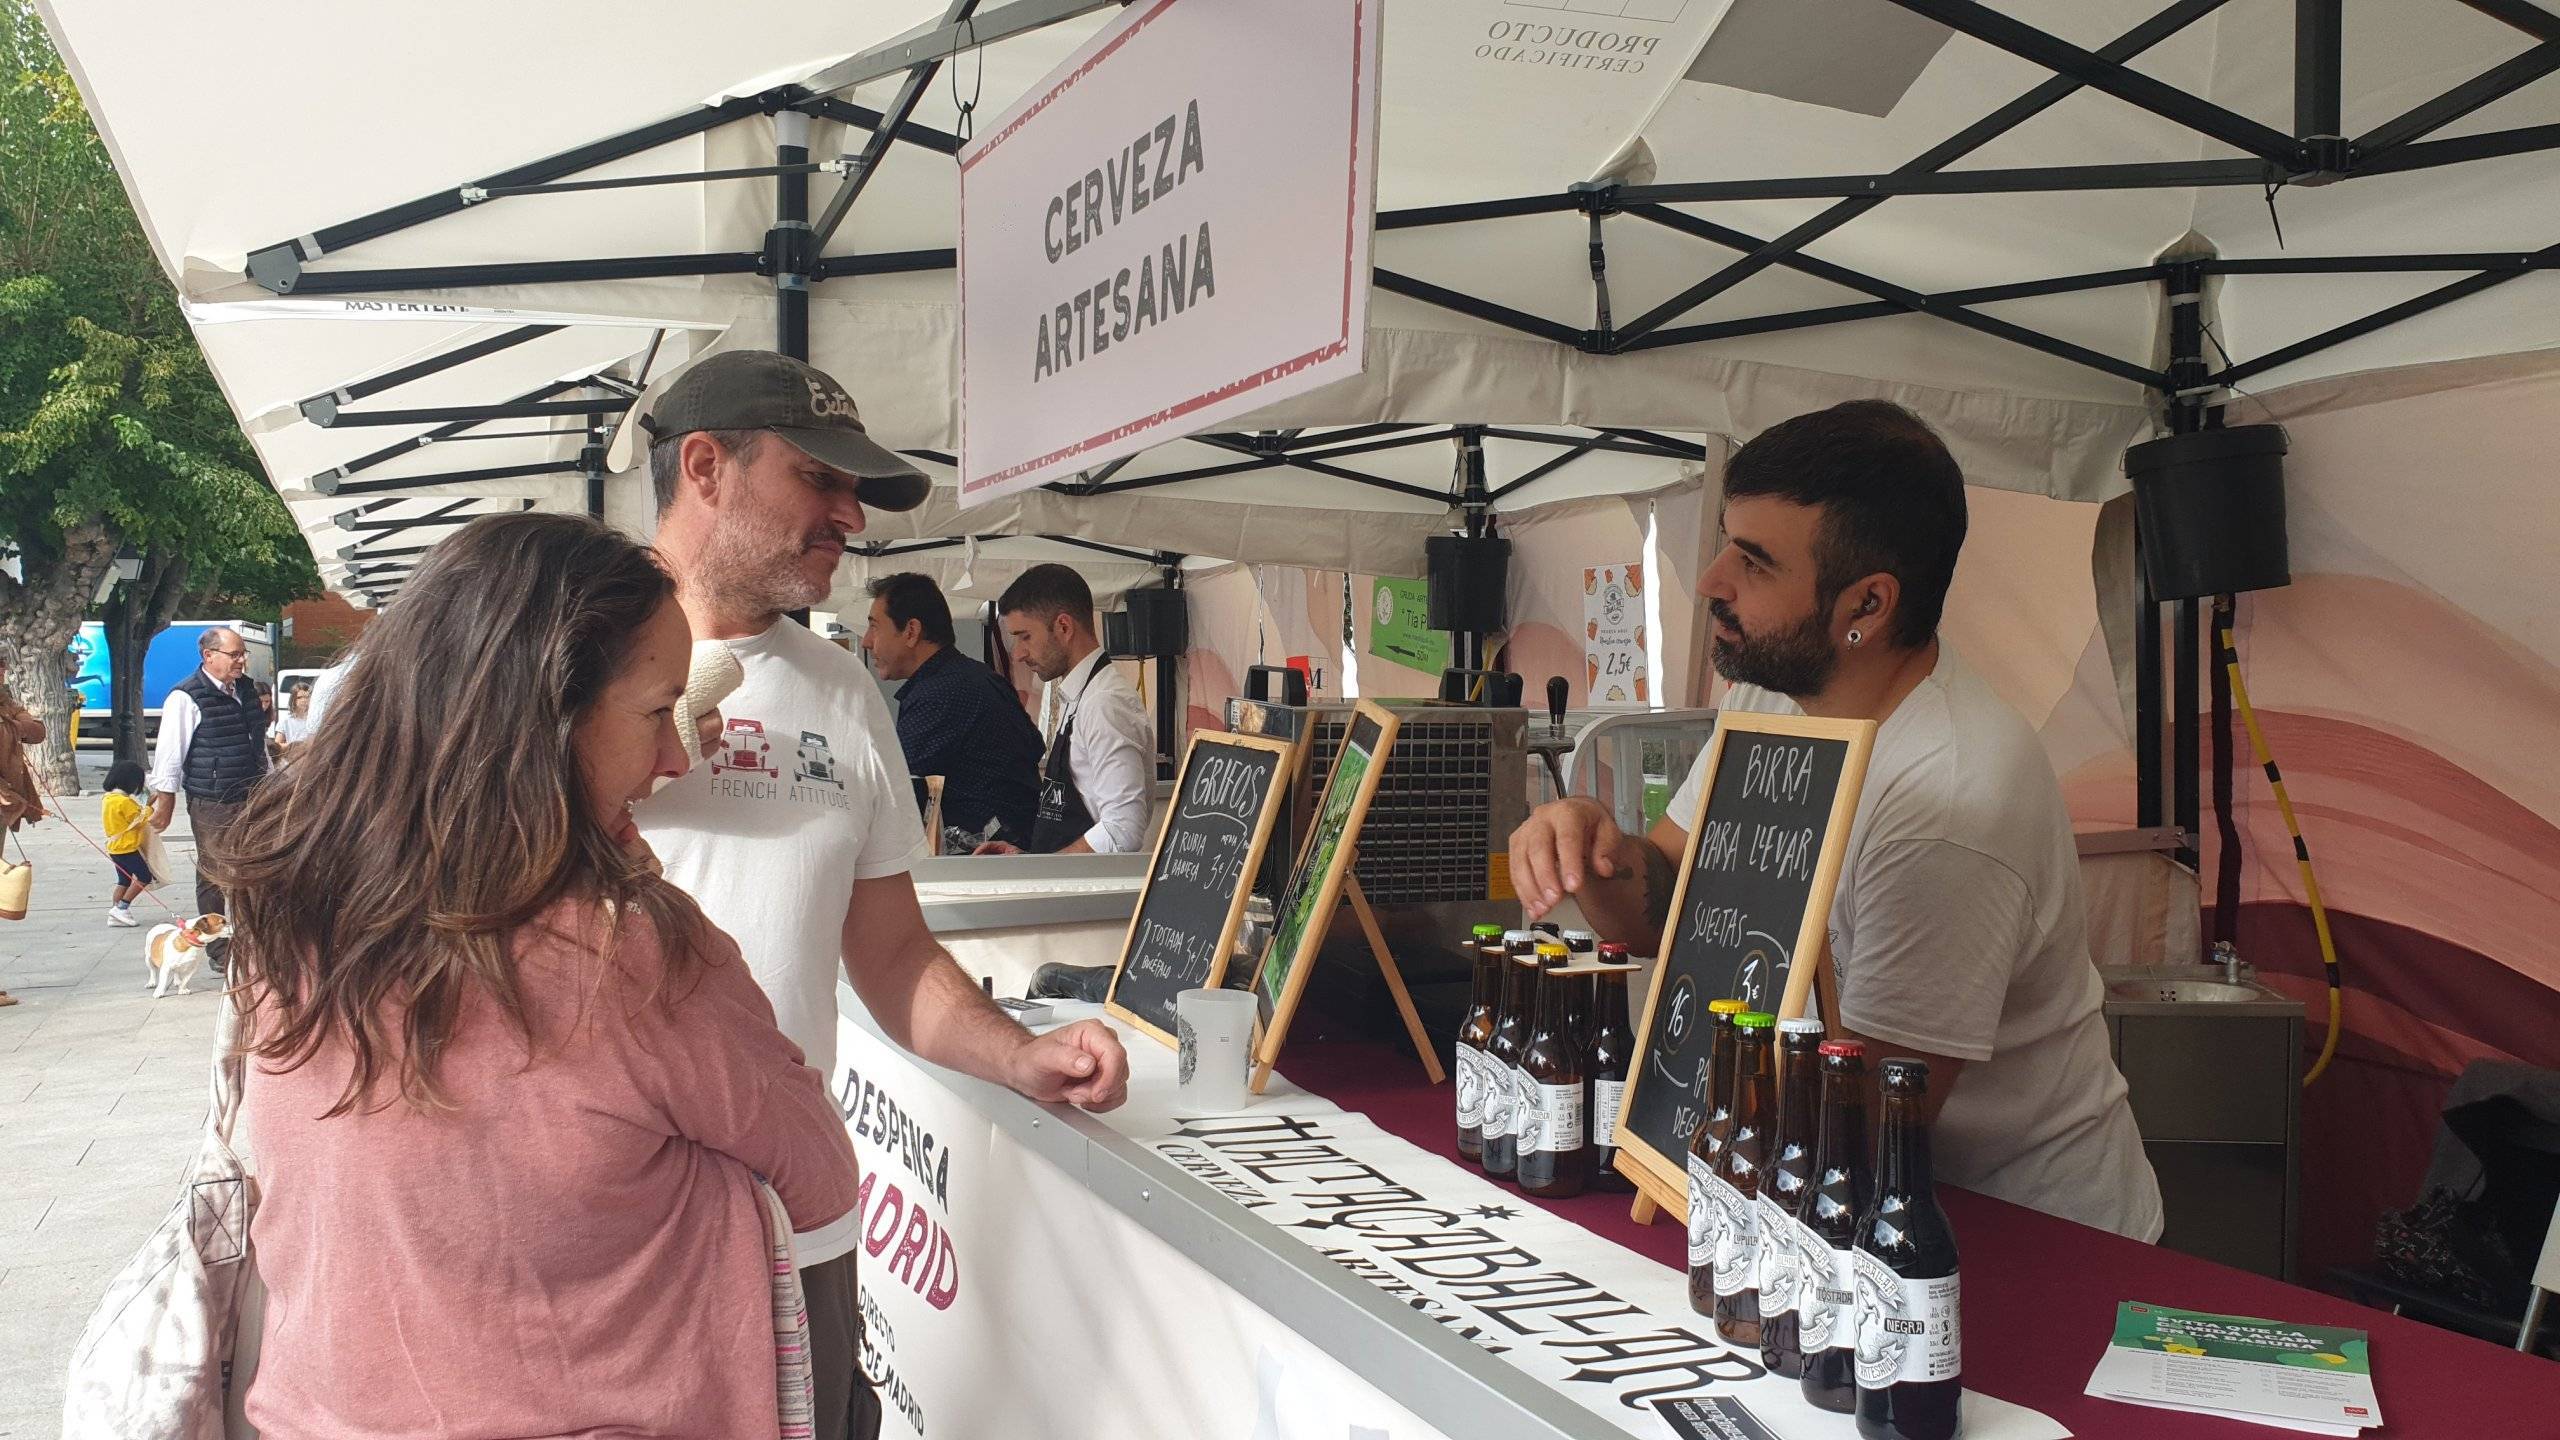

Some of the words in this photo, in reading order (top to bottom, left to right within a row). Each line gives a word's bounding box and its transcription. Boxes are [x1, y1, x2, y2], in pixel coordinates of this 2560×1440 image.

[1044, 98, 1205, 265] CERVEZA
[1033, 221, 1217, 384] ARTESANA
[711, 778, 777, 800] FRENCH
[789, 785, 851, 811] ATTITUDE
[1192, 756, 1266, 819] GRIFOS
[1742, 743, 1814, 806] BIRRA
[1179, 831, 1208, 857] RUBIA
[1697, 820, 1742, 873] PARA
[1749, 823, 1813, 882] LLEVAR
[1151, 924, 1185, 956] TOSTADA
[1689, 901, 1748, 949] SUELTAS
[841, 1066, 950, 1217] DESPENSA
[1155, 1143, 1278, 1210] CERVEZA
[1886, 1319, 1924, 1334] NEGRA
[2155, 1326, 2184, 1335] EN
[2223, 1335, 2318, 1350] BASURA
[2156, 1316, 2221, 1329] EVITA
[2225, 1325, 2272, 1335] QUE
[2276, 1330, 2306, 1338] LA
[2250, 1333, 2325, 1345] ACABE
[883, 1363, 925, 1437] MADRID
